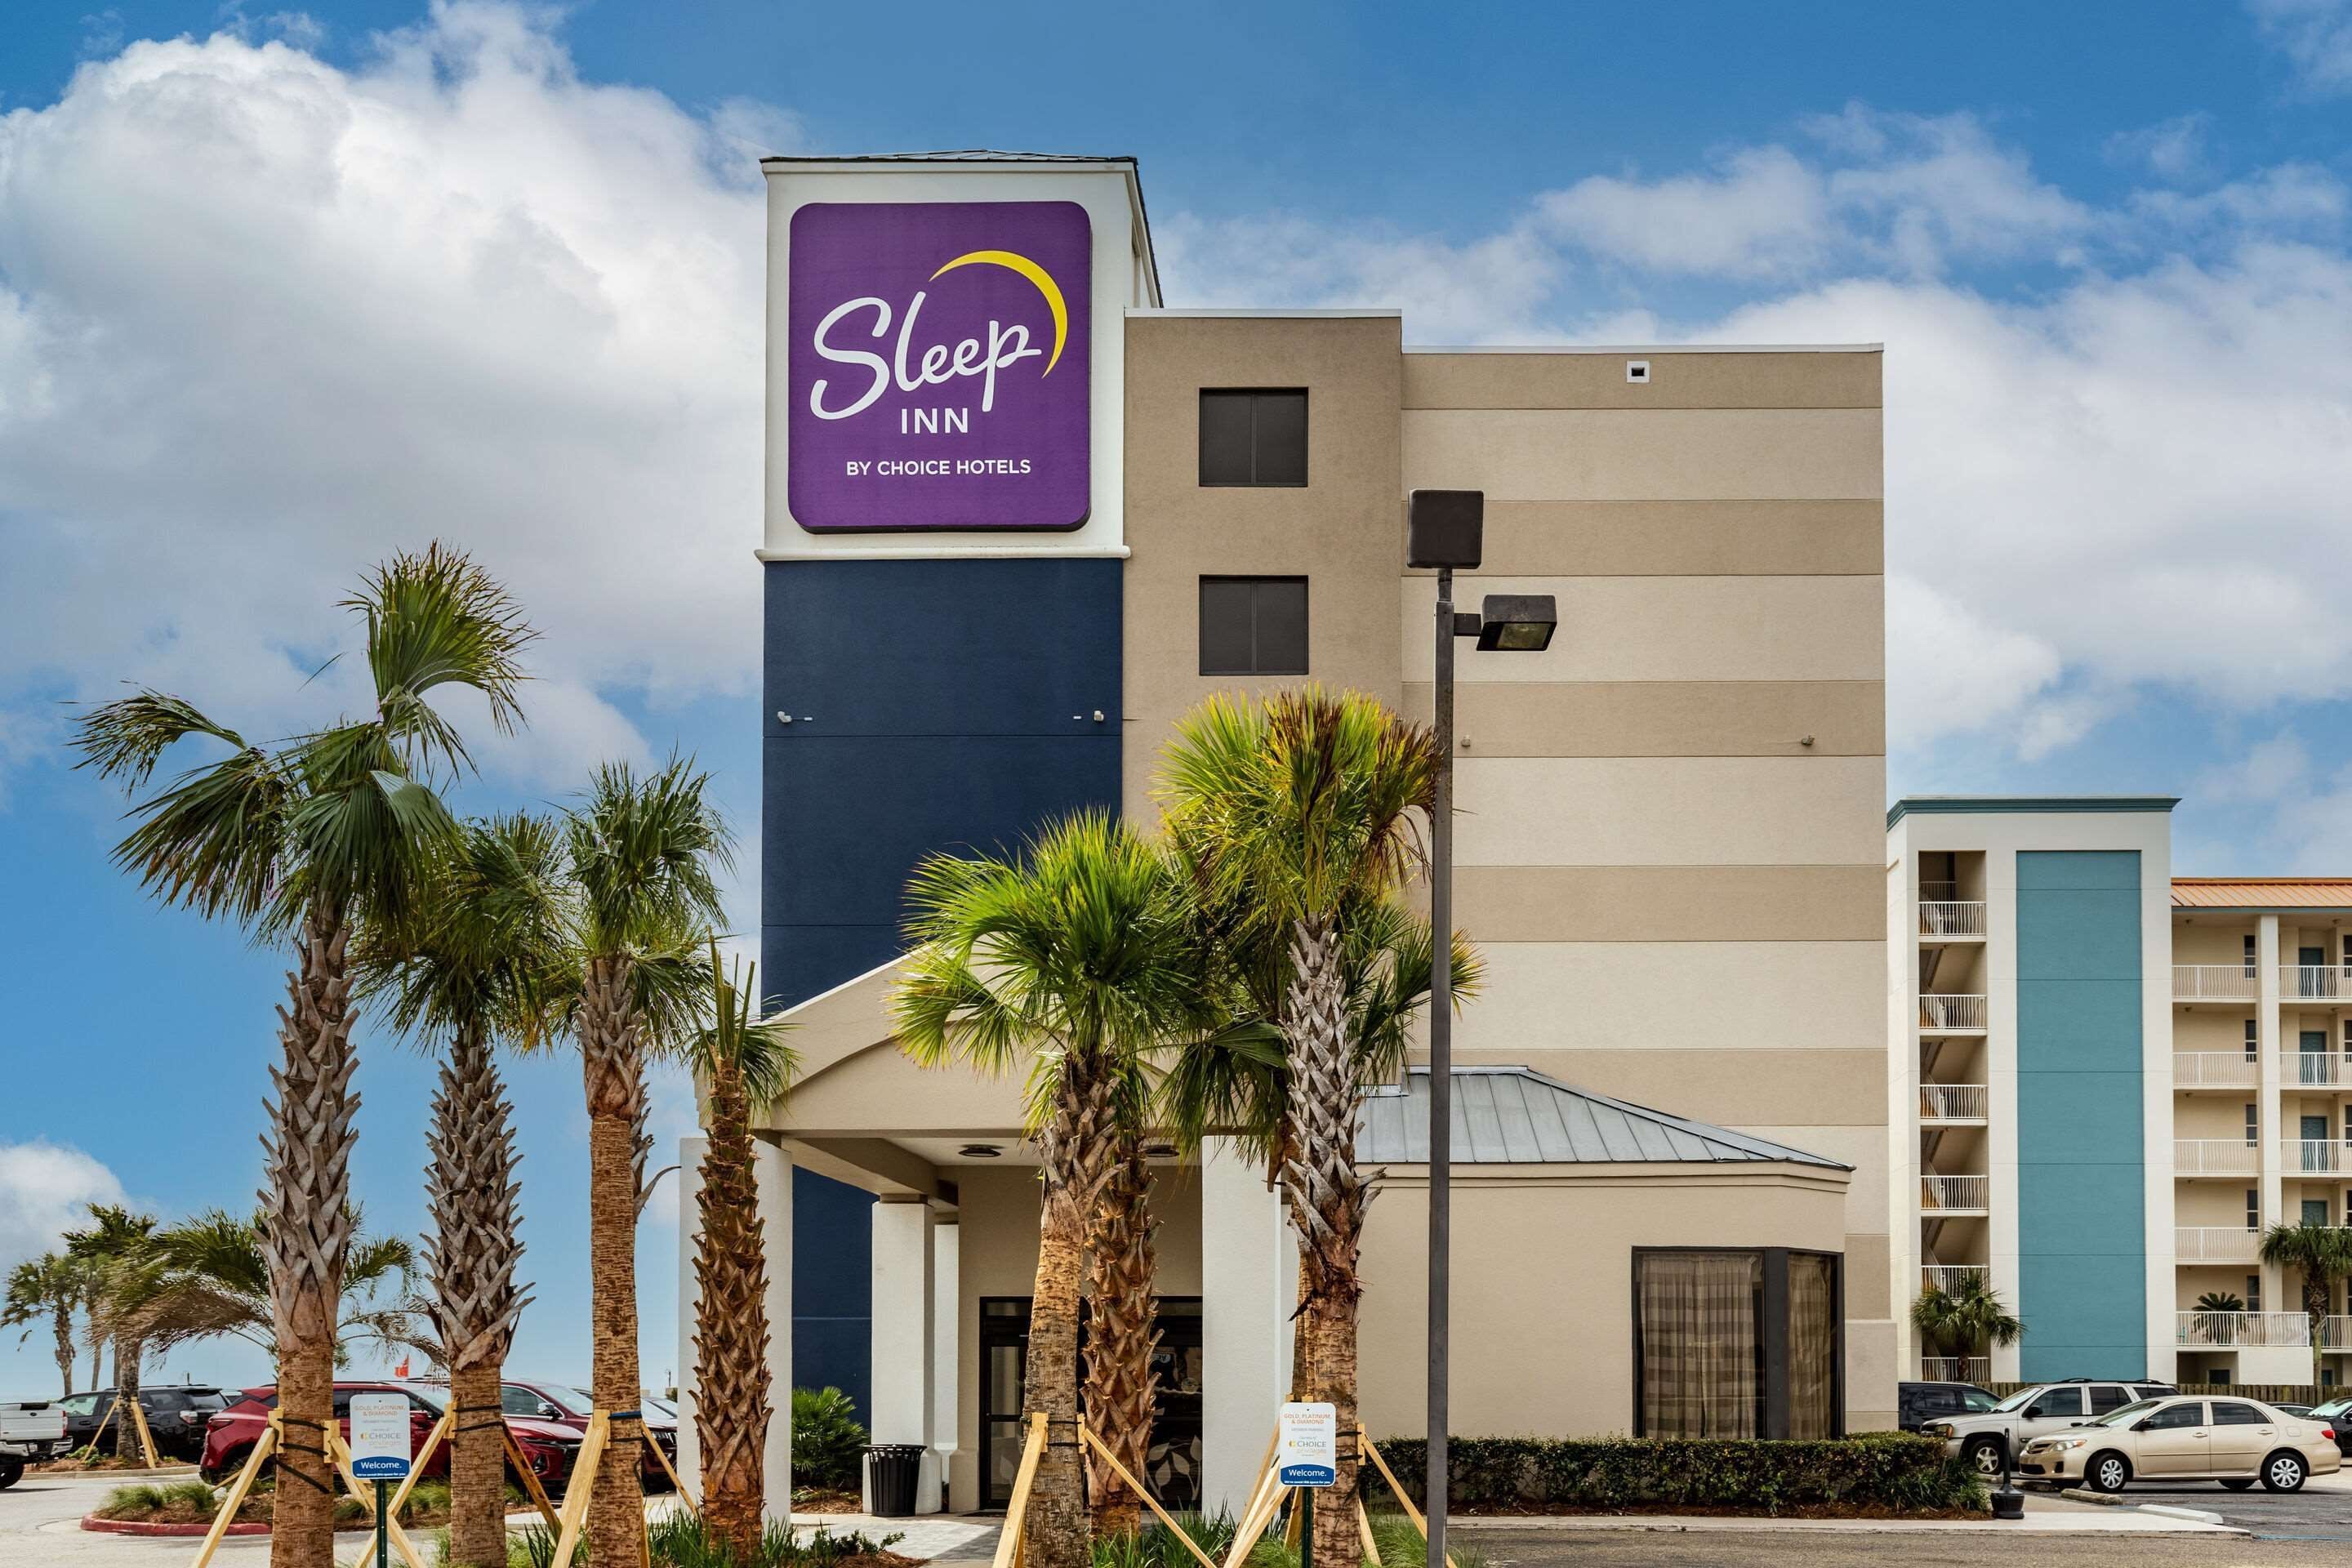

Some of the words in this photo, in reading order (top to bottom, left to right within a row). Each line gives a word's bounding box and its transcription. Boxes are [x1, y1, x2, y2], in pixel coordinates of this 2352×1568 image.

[809, 291, 1041, 421] Sleep
[901, 408, 969, 434] INN
[846, 461, 870, 476] BY
[876, 460, 951, 475] CHOICE
[956, 459, 1031, 474] HOTELS
[360, 1461, 403, 1469] Welcome.
